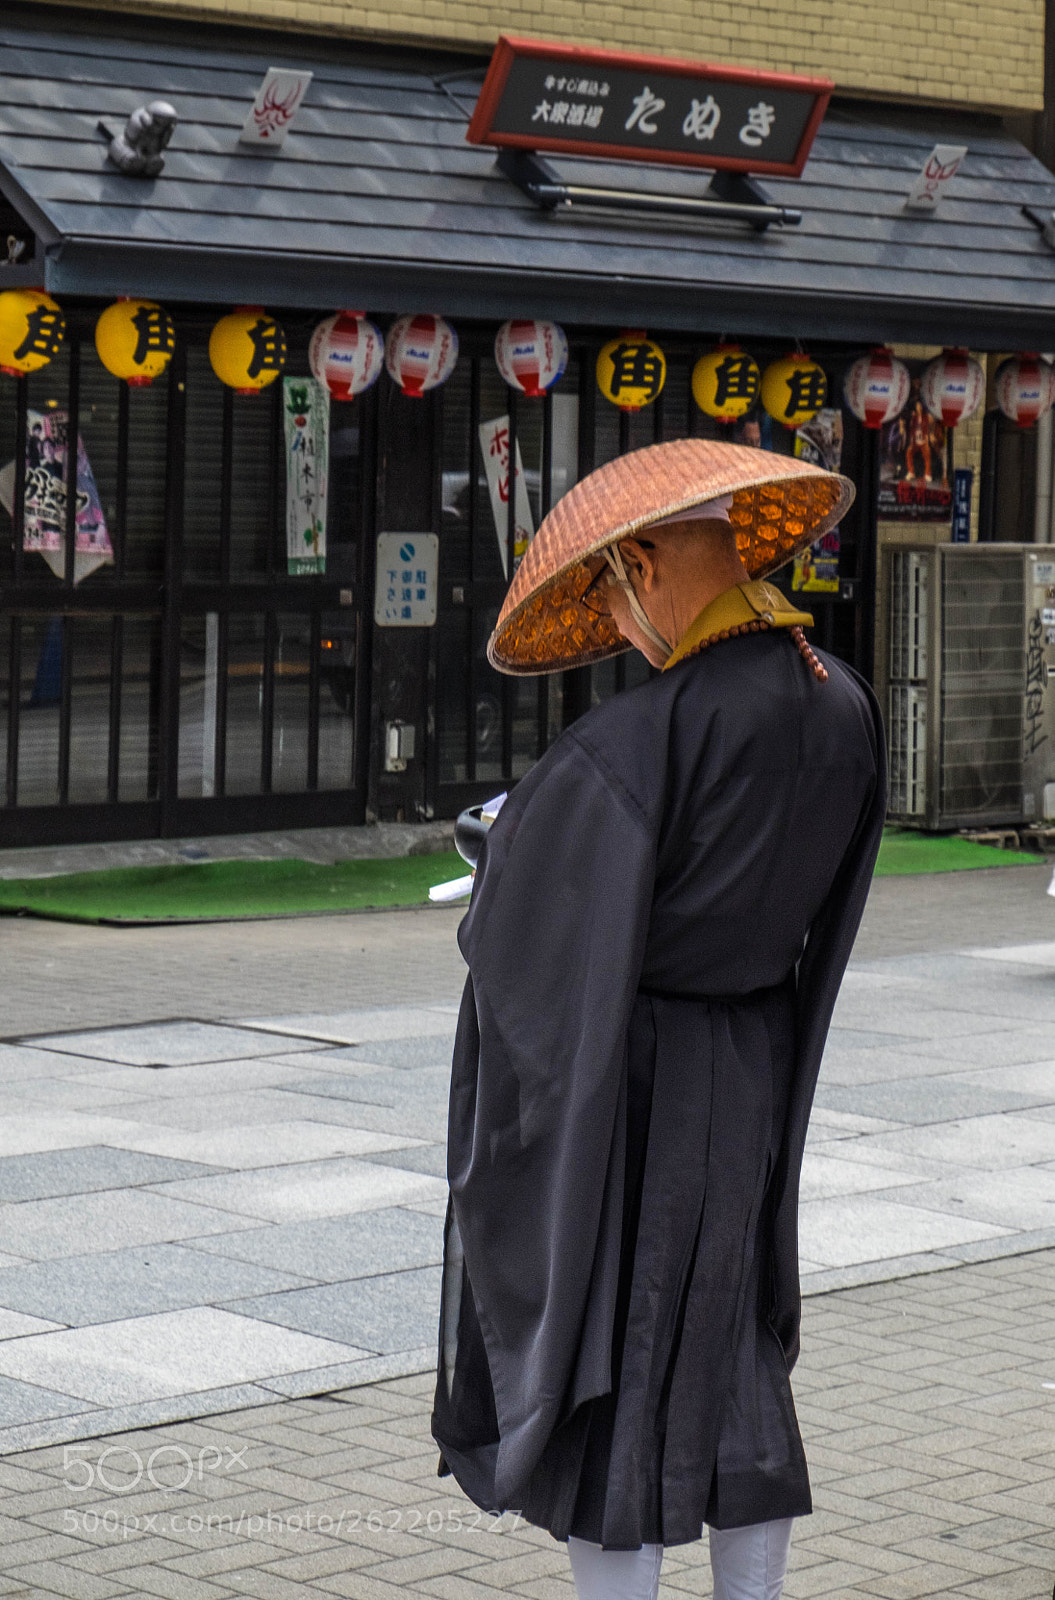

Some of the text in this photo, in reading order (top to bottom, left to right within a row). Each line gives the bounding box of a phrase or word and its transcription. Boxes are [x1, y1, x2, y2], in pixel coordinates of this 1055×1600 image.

[531, 99, 604, 128] 大衆酒場
[625, 86, 775, 147] たぬき
[13, 304, 66, 362] 角
[130, 305, 176, 367] 角
[246, 318, 287, 380] 角
[609, 344, 663, 403] 角
[714, 356, 761, 408] 角
[784, 369, 828, 419] 角
